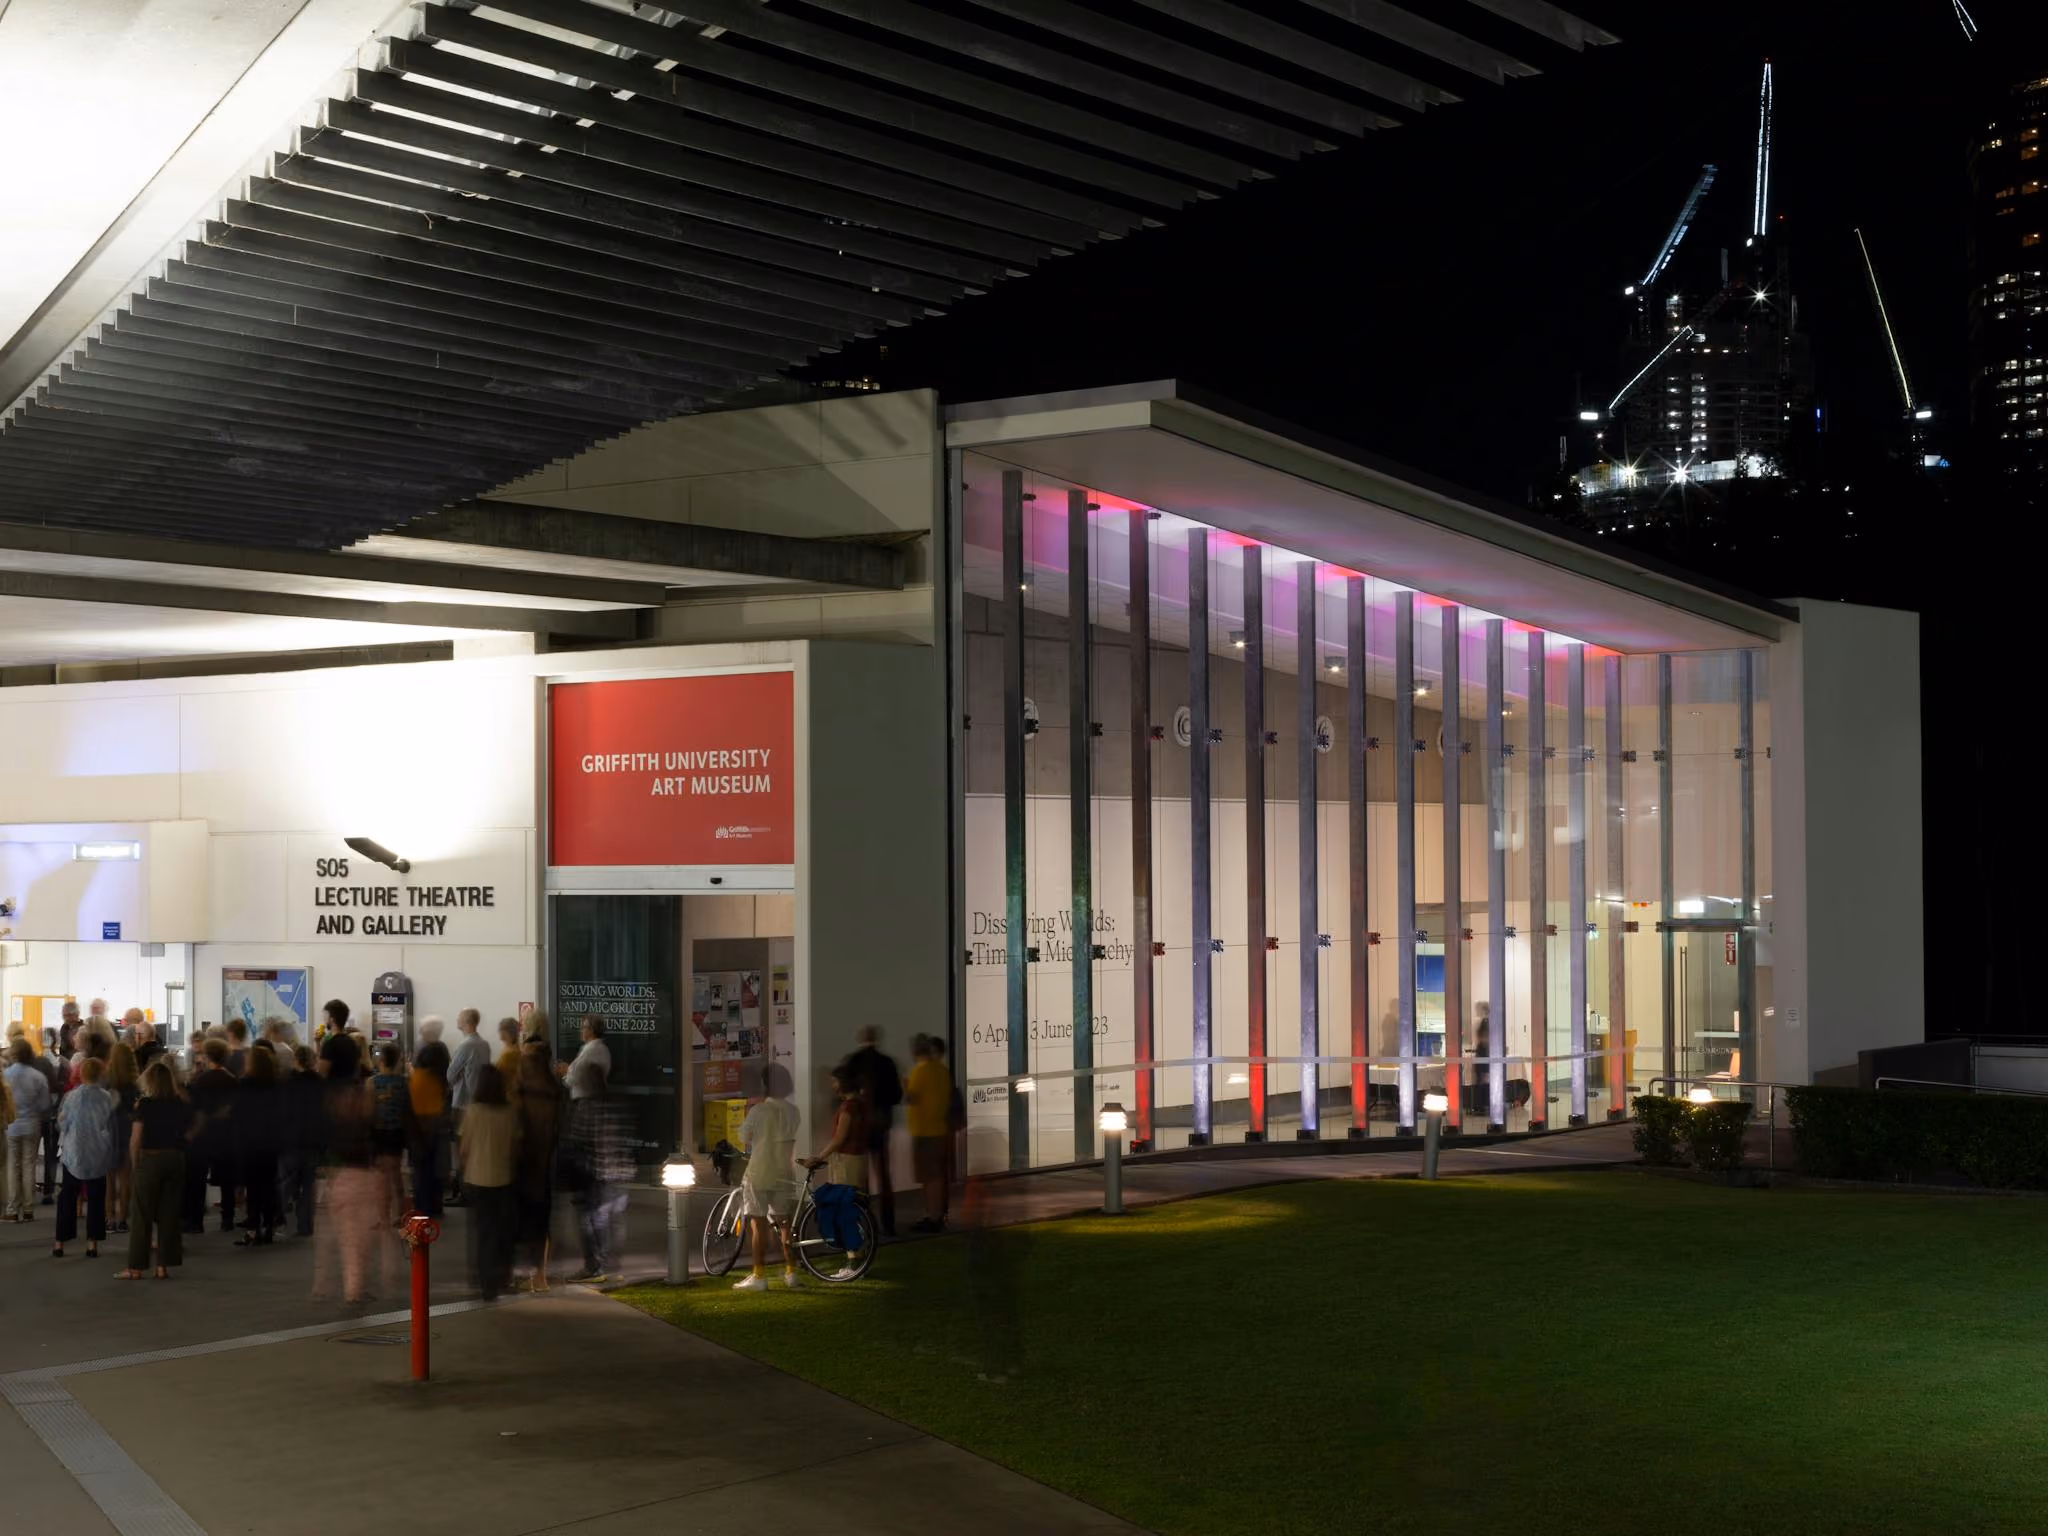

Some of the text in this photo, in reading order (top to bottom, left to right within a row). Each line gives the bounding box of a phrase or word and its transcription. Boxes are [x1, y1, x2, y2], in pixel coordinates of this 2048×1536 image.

[581, 749, 771, 773] GRIFFITH UNIVERSITY
[651, 774, 771, 796] ART MUSEUM
[316, 858, 349, 877] S05
[315, 886, 495, 907] LECTURE THEATRE
[316, 915, 447, 935] AND GALLERY
[973, 909, 1115, 940] Dissving Wlds:
[560, 984, 656, 998] SOLVING WORLDS:
[565, 1002, 656, 1015] AND MIC GRUCHY
[630, 1019, 656, 1031] 2023
[972, 1023, 982, 1043] 6
[1041, 1020, 1073, 1040] June
